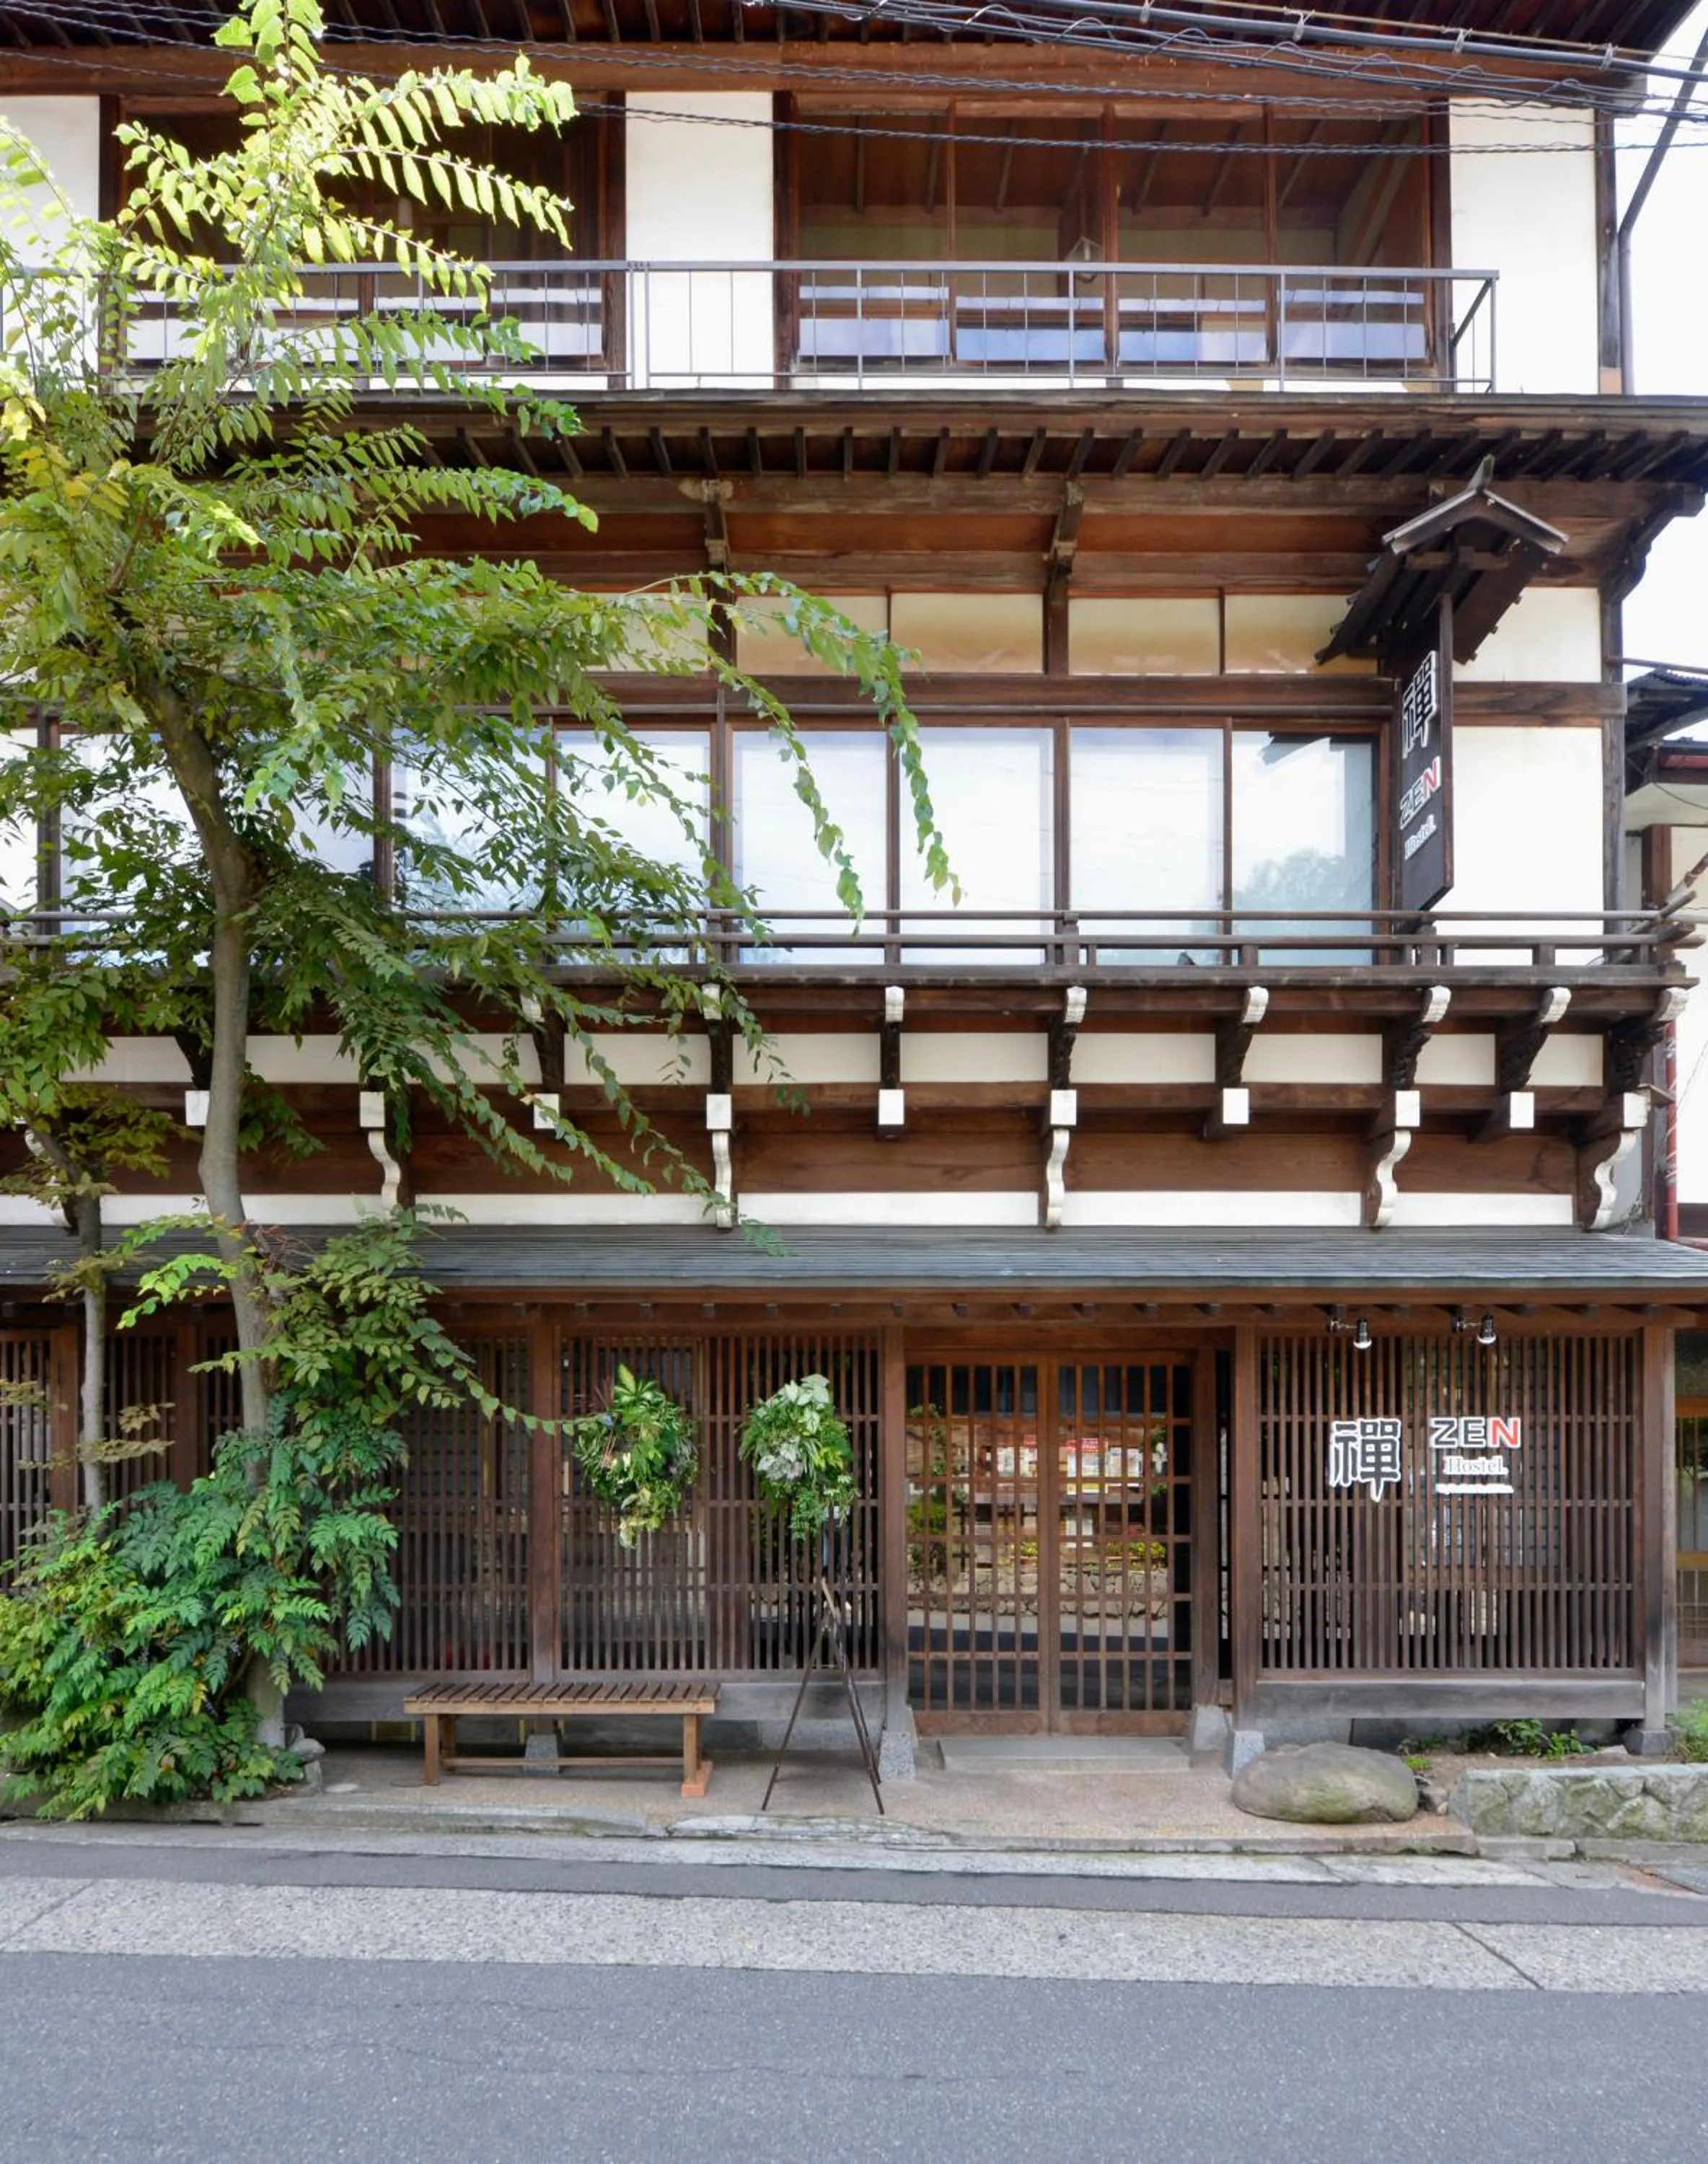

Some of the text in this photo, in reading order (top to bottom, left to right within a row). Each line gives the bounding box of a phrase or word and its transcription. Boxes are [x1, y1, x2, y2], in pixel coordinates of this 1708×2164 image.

[1400, 756, 1441, 830] ZEN
[1429, 1417, 1521, 1448] ZEN
[1329, 1418, 1401, 1503] 禪
[1443, 1456, 1509, 1475] Hostel
